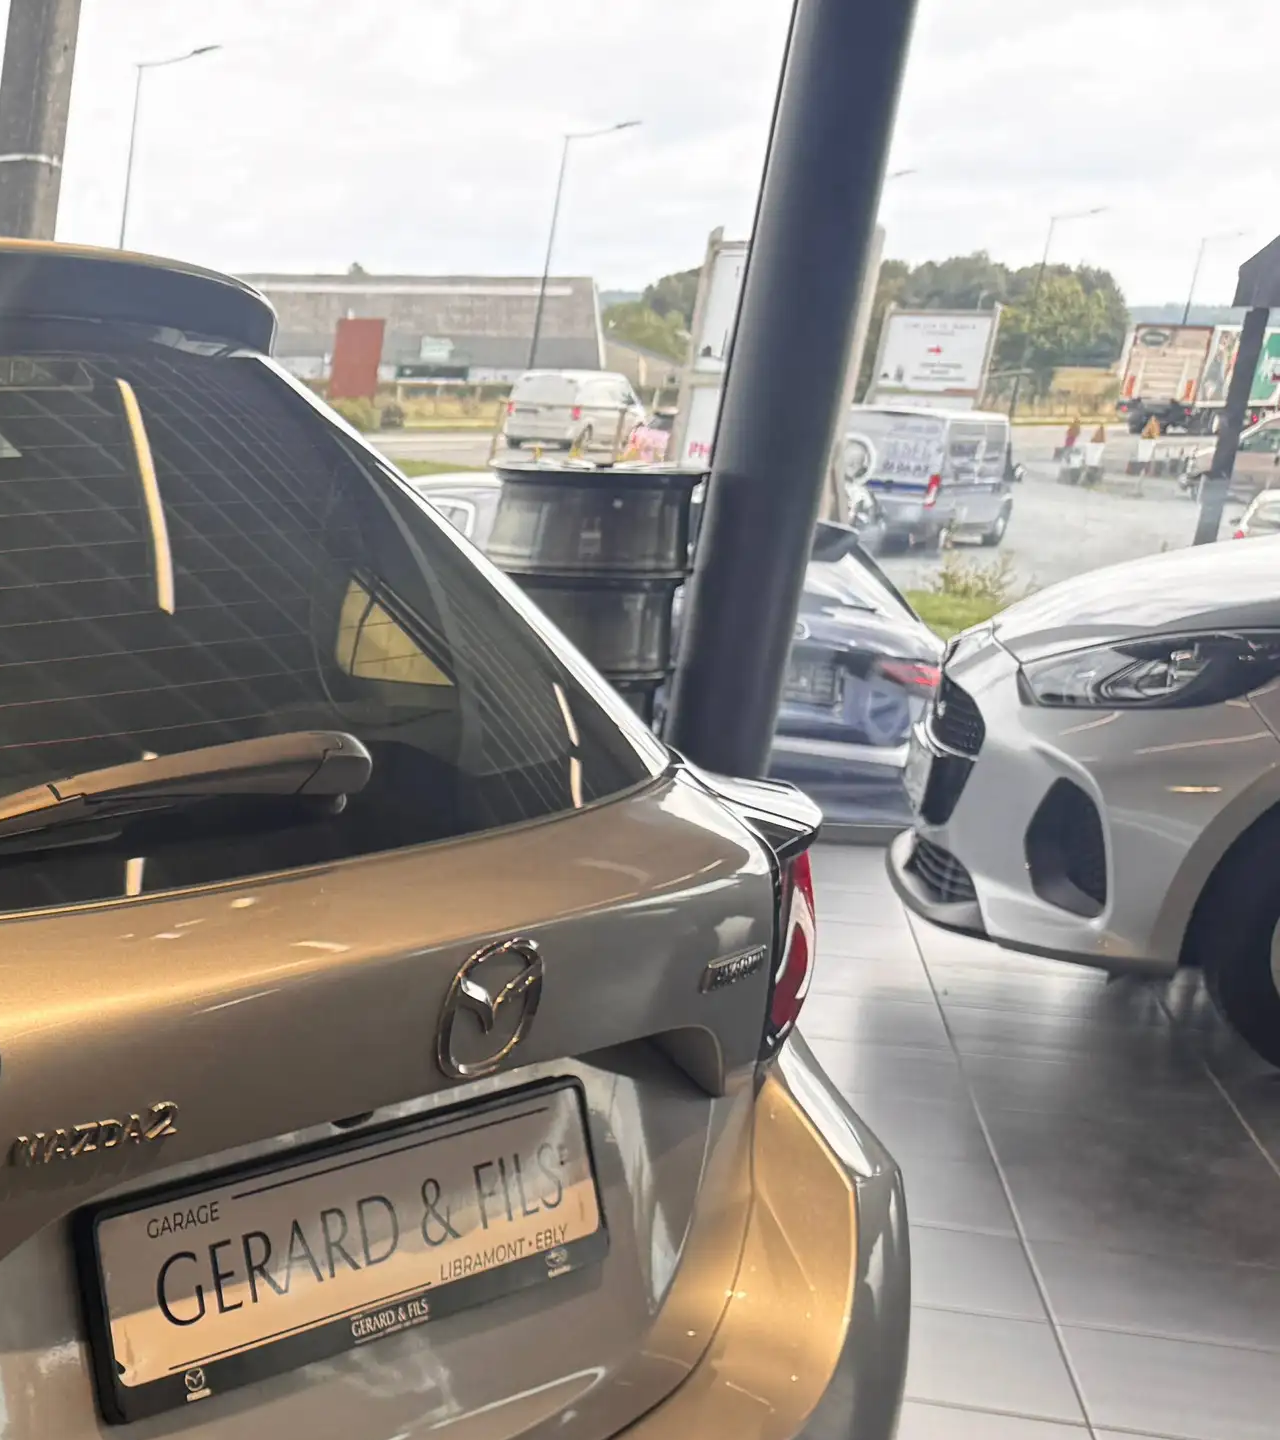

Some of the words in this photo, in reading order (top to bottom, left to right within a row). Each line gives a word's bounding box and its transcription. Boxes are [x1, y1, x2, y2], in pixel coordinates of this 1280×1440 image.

[7, 1100, 179, 1166] MAZDA2
[146, 1201, 220, 1239] GARAGE
[156, 1194, 400, 1327] GERARD
[420, 1177, 464, 1247] &
[473, 1142, 563, 1230] FILS
[440, 1237, 526, 1282] LIBRAMONT
[535, 1223, 568, 1250] EBLY
[351, 1309, 396, 1338] GERARD
[397, 1306, 407, 1322] &
[407, 1298, 429, 1318] FILS
